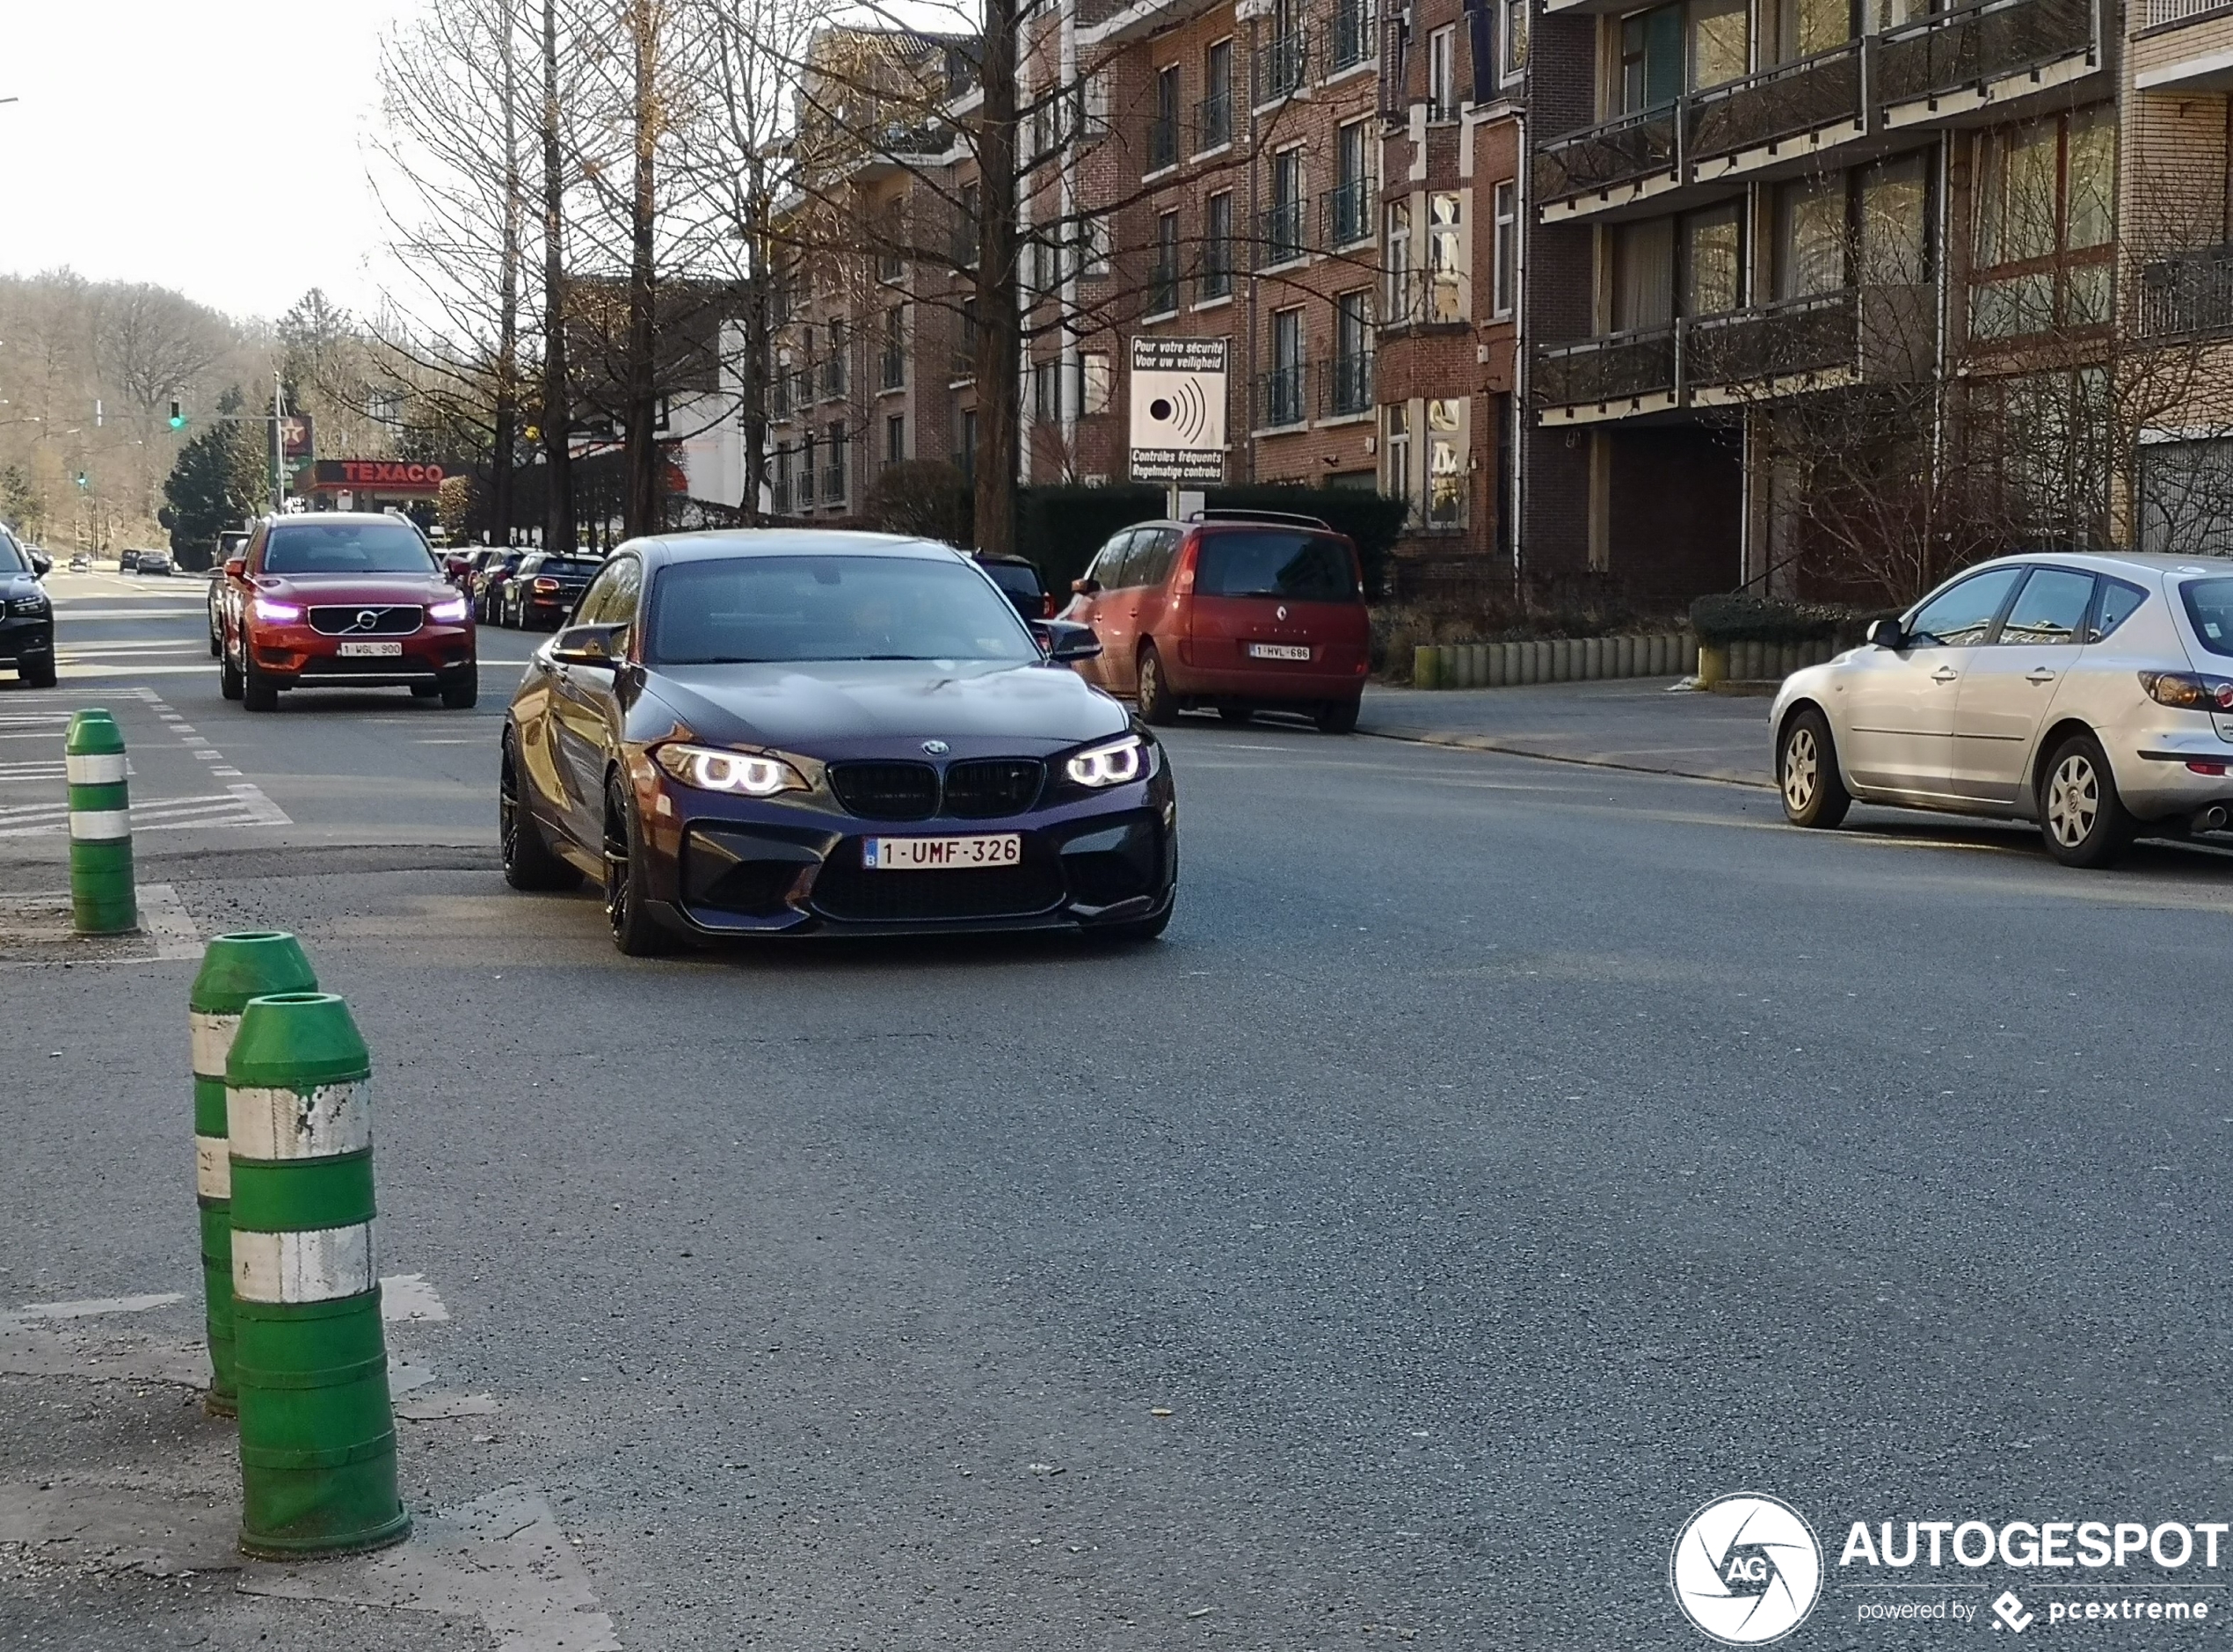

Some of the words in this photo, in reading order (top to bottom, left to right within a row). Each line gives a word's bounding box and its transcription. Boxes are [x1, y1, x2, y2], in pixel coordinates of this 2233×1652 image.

[1134, 339, 1156, 353] Pour
[1160, 341, 1183, 353] votre
[1186, 342, 1223, 354] sécurité
[1136, 354, 1156, 368] Voor
[1159, 358, 1174, 368] uw
[1177, 356, 1221, 371] veiligheid
[1178, 450, 1221, 465] fréquents
[342, 462, 443, 482] TEXACO
[1132, 463, 1182, 480] Regelmatige
[1183, 466, 1221, 477] controles
[866, 855, 876, 866] B
[884, 839, 1017, 864] 1-UMF-326
